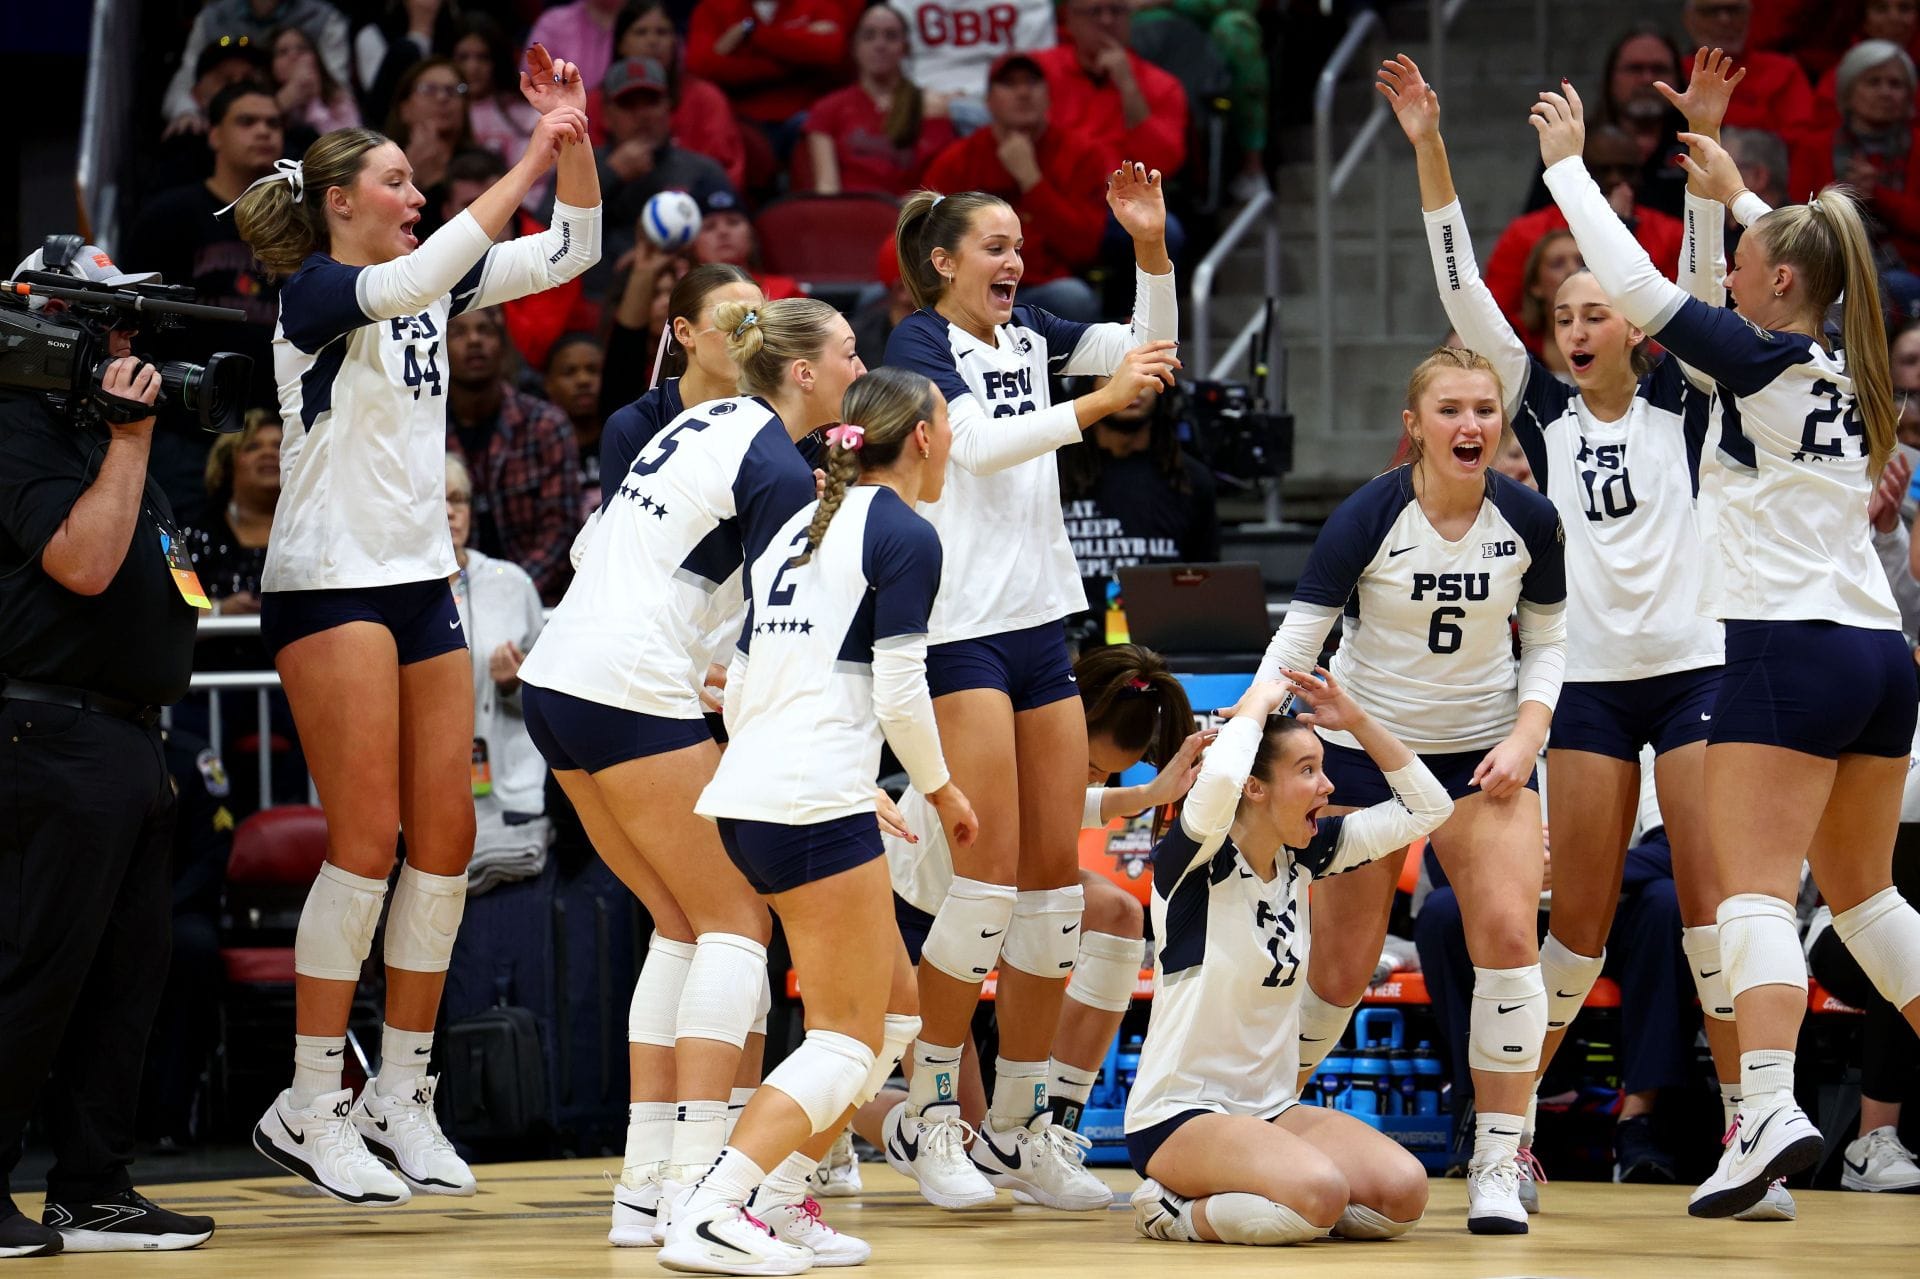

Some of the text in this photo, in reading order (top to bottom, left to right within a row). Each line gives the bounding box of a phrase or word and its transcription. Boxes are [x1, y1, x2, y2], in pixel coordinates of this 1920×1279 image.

[917, 3, 1018, 47] GBR
[1443, 224, 1461, 291] PENN STATE
[1689, 236, 1697, 273] NITTANY
[47, 340, 72, 349] SONY
[403, 341, 441, 400] 44
[983, 367, 1032, 399] PSU
[630, 418, 710, 476] 5
[1581, 467, 1637, 521] 10
[767, 525, 817, 606] 2
[1411, 572, 1490, 601] PSU
[1428, 606, 1466, 654] 6
[1261, 937, 1300, 987] 11
